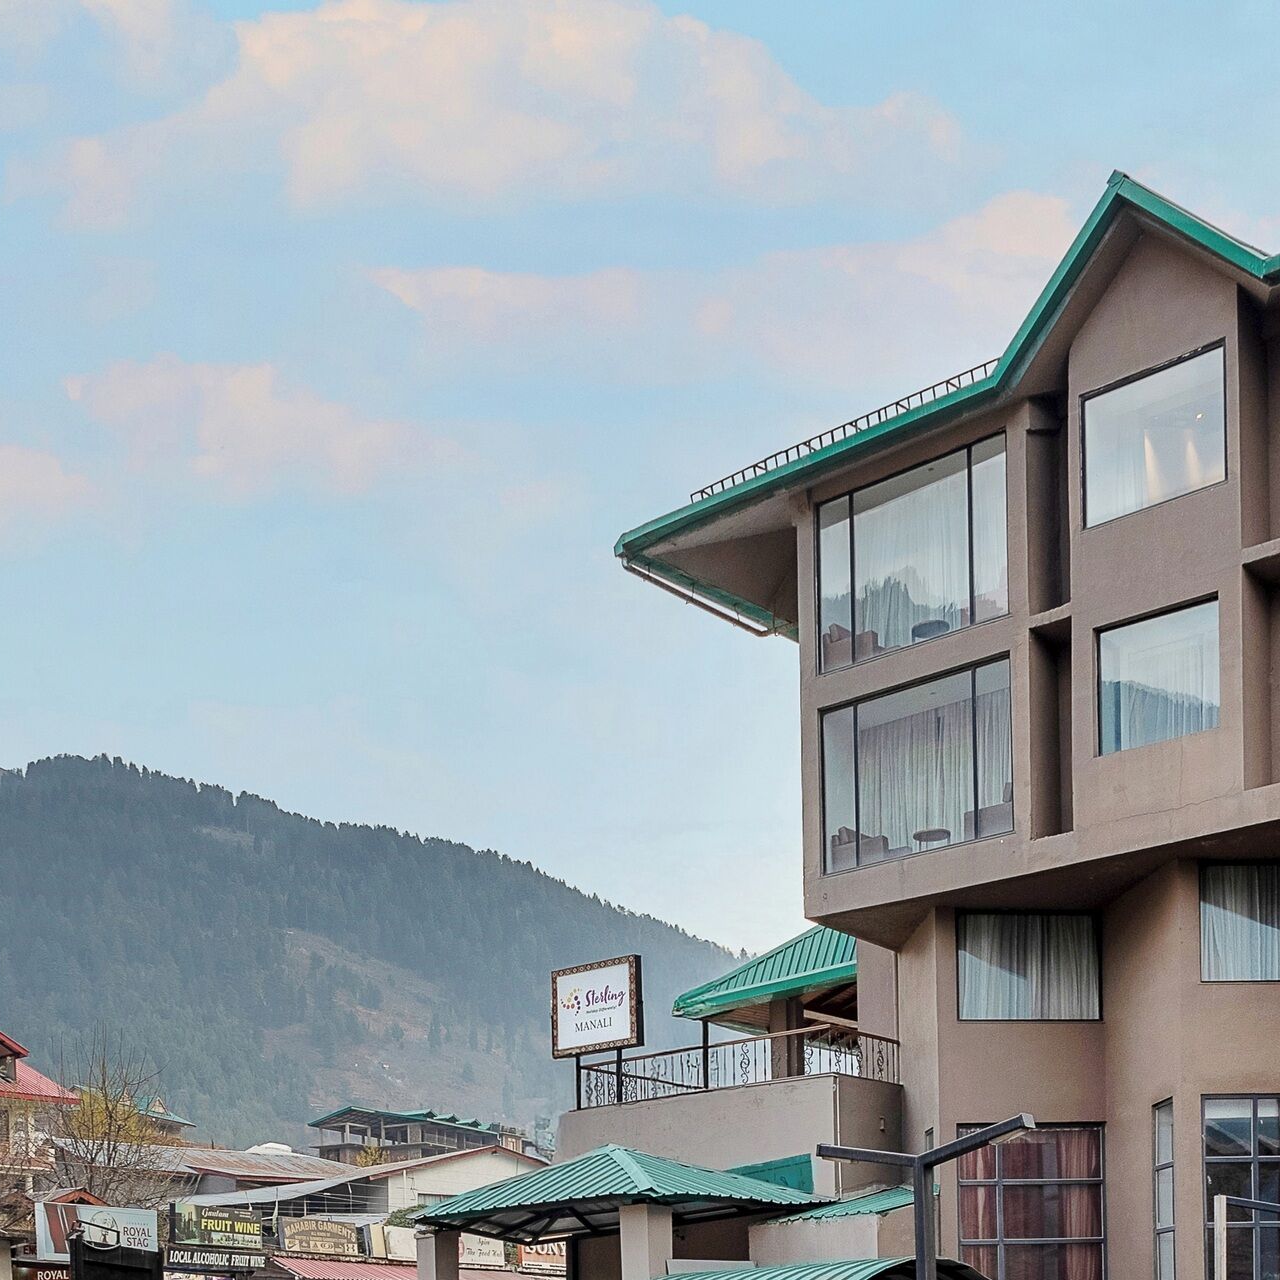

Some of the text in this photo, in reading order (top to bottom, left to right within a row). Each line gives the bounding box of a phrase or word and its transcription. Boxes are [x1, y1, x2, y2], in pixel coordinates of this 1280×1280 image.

[585, 985, 626, 1007] Sterling
[575, 1017, 612, 1032] MANALI
[123, 1226, 152, 1238] ROYAL
[201, 1219, 261, 1234] FRUIT WINE
[284, 1220, 317, 1238] MAHABIR
[317, 1221, 356, 1242] GARMENTS
[126, 1237, 149, 1248] STAG
[169, 1250, 265, 1267] LOCAL ALCOHOLIC FRUIT WINE
[37, 1270, 70, 1280] ROYAL
